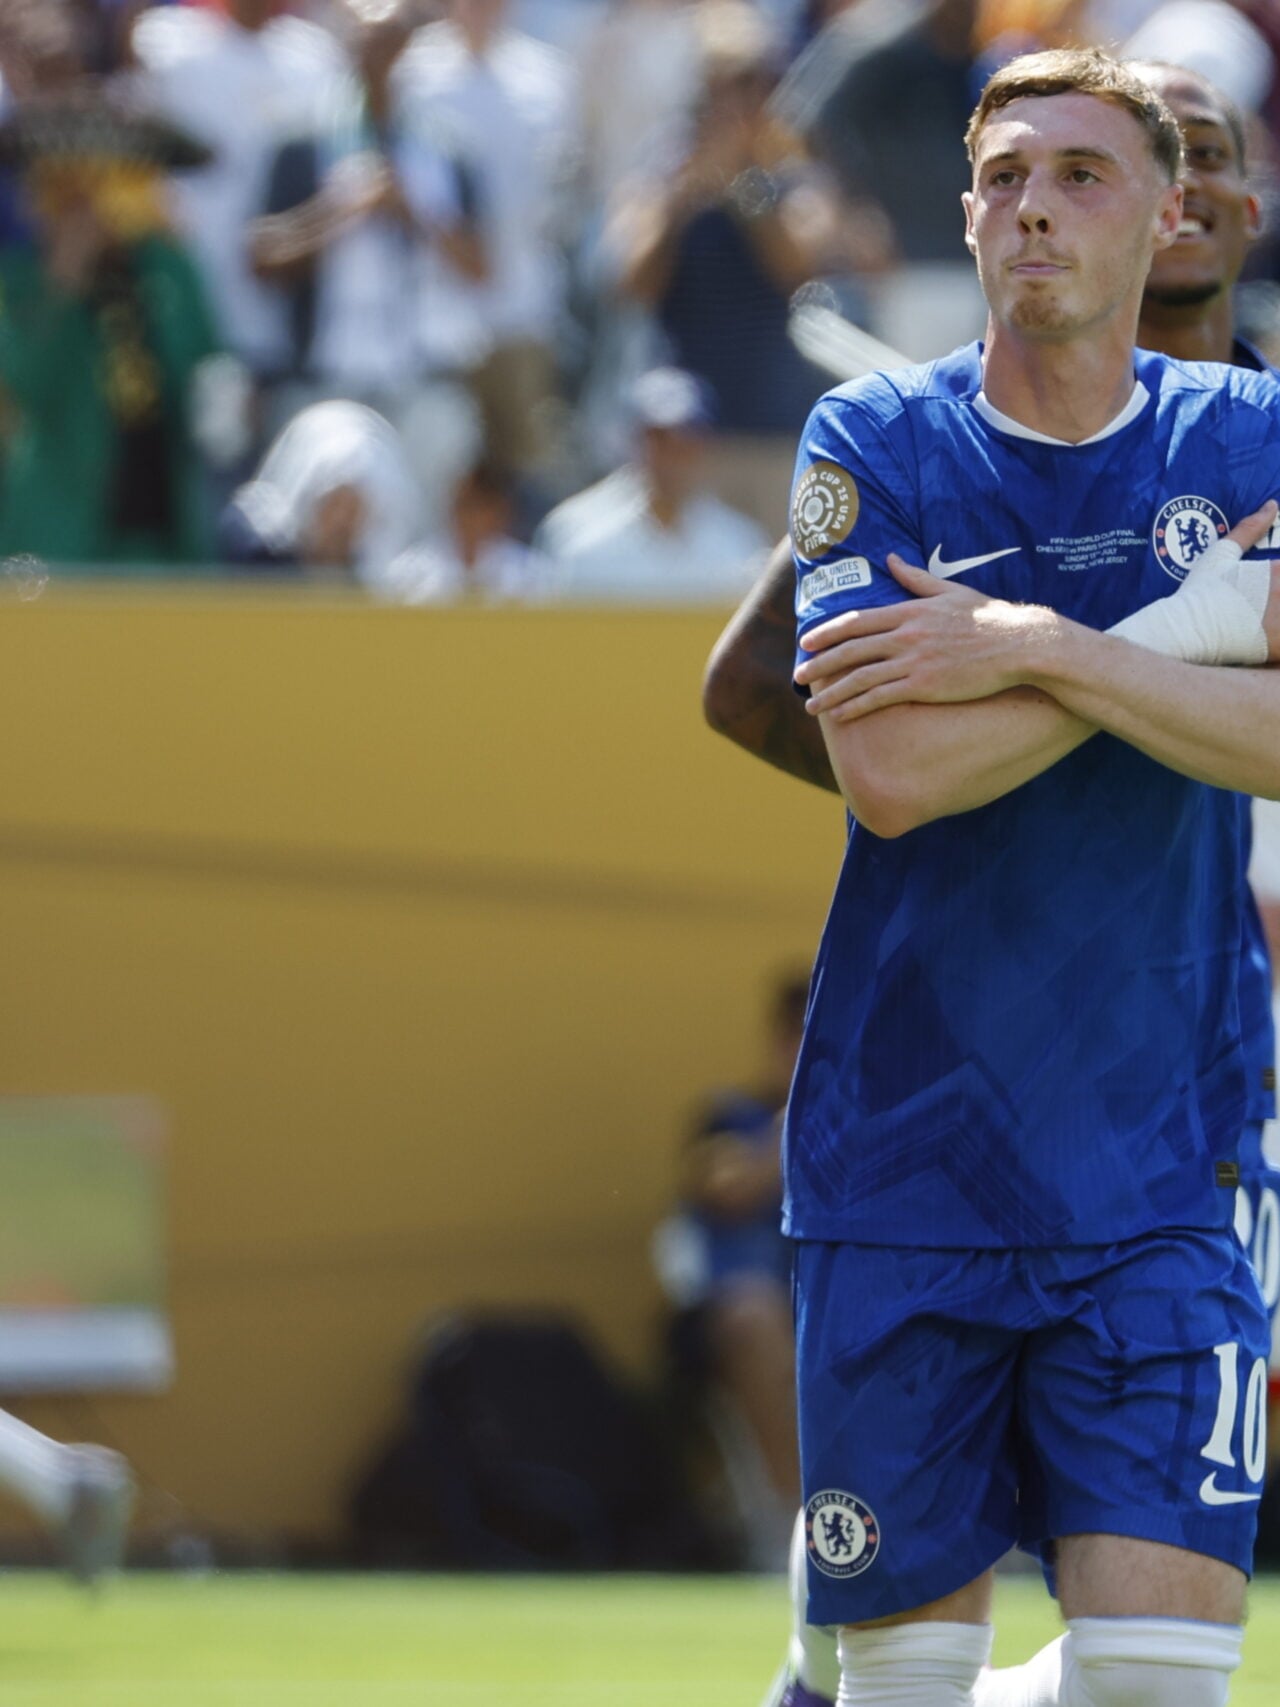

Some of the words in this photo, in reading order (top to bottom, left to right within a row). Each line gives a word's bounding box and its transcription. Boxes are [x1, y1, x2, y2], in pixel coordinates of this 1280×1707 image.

[820, 471, 840, 485] CUP
[837, 486, 848, 501] 25
[832, 505, 848, 529] USA
[1163, 499, 1213, 519] CHELSEA
[804, 533, 828, 553] FIFA
[829, 560, 859, 575] UNITES
[1200, 1341, 1267, 1484] 10
[809, 1494, 856, 1513] CHELSEA
